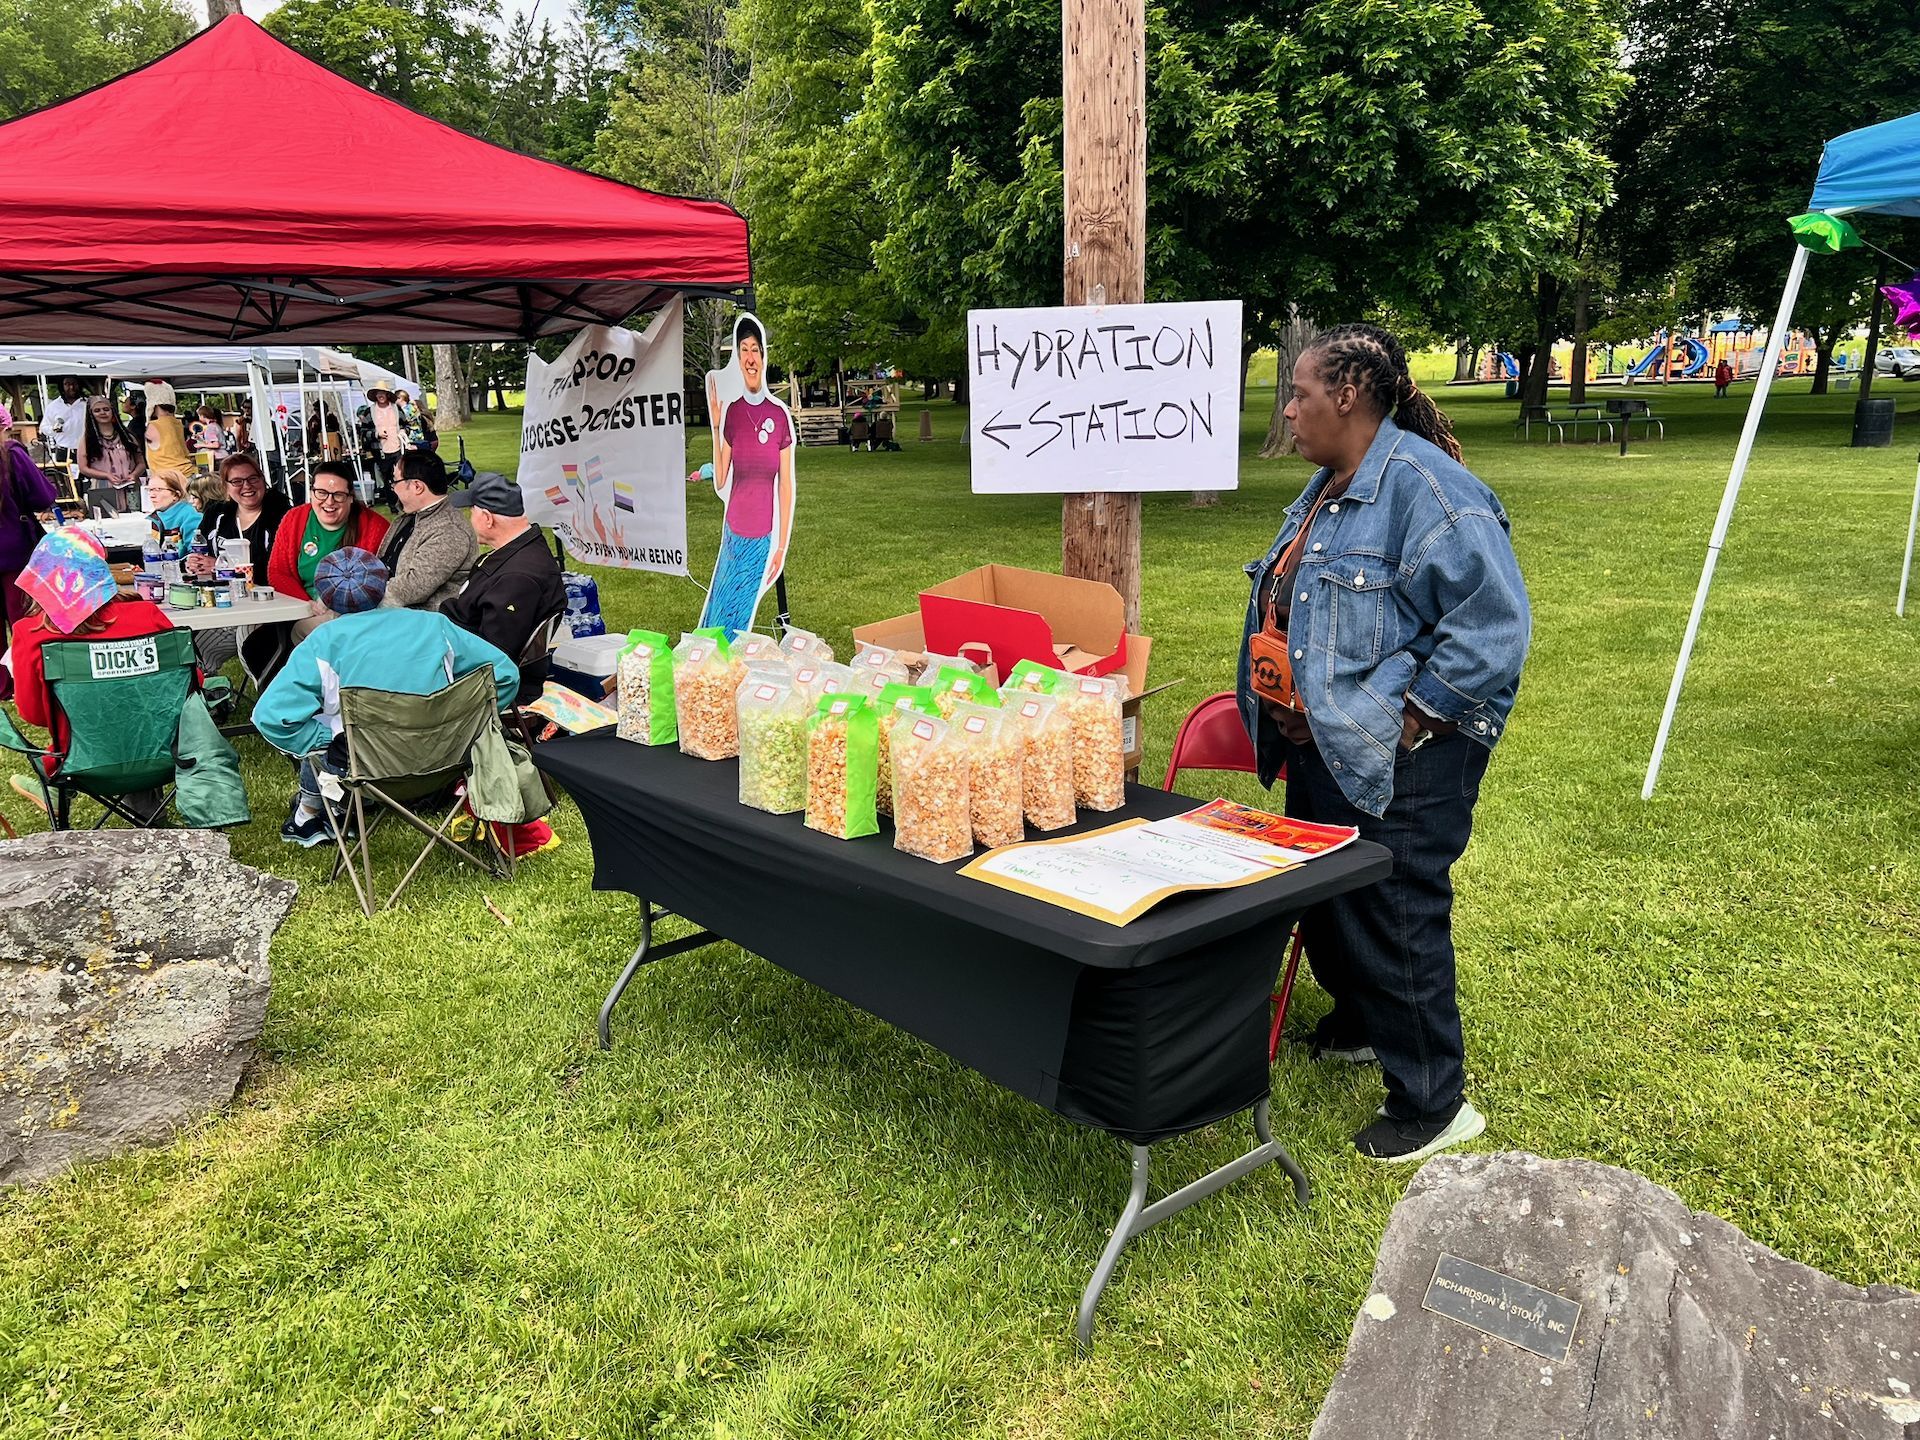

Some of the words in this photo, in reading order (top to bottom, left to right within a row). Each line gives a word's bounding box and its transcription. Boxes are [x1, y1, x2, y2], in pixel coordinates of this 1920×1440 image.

[976, 317, 1214, 390] HYDRATION
[1026, 392, 1213, 457] STATION
[594, 542, 616, 558] EVERY
[615, 546, 647, 562] HUMAN
[648, 548, 683, 565] BEING
[94, 647, 155, 670] DICK'S
[1435, 1277, 1496, 1305] RICHARDSON
[1498, 1300, 1507, 1311] &
[1547, 1319, 1567, 1335] INC.
